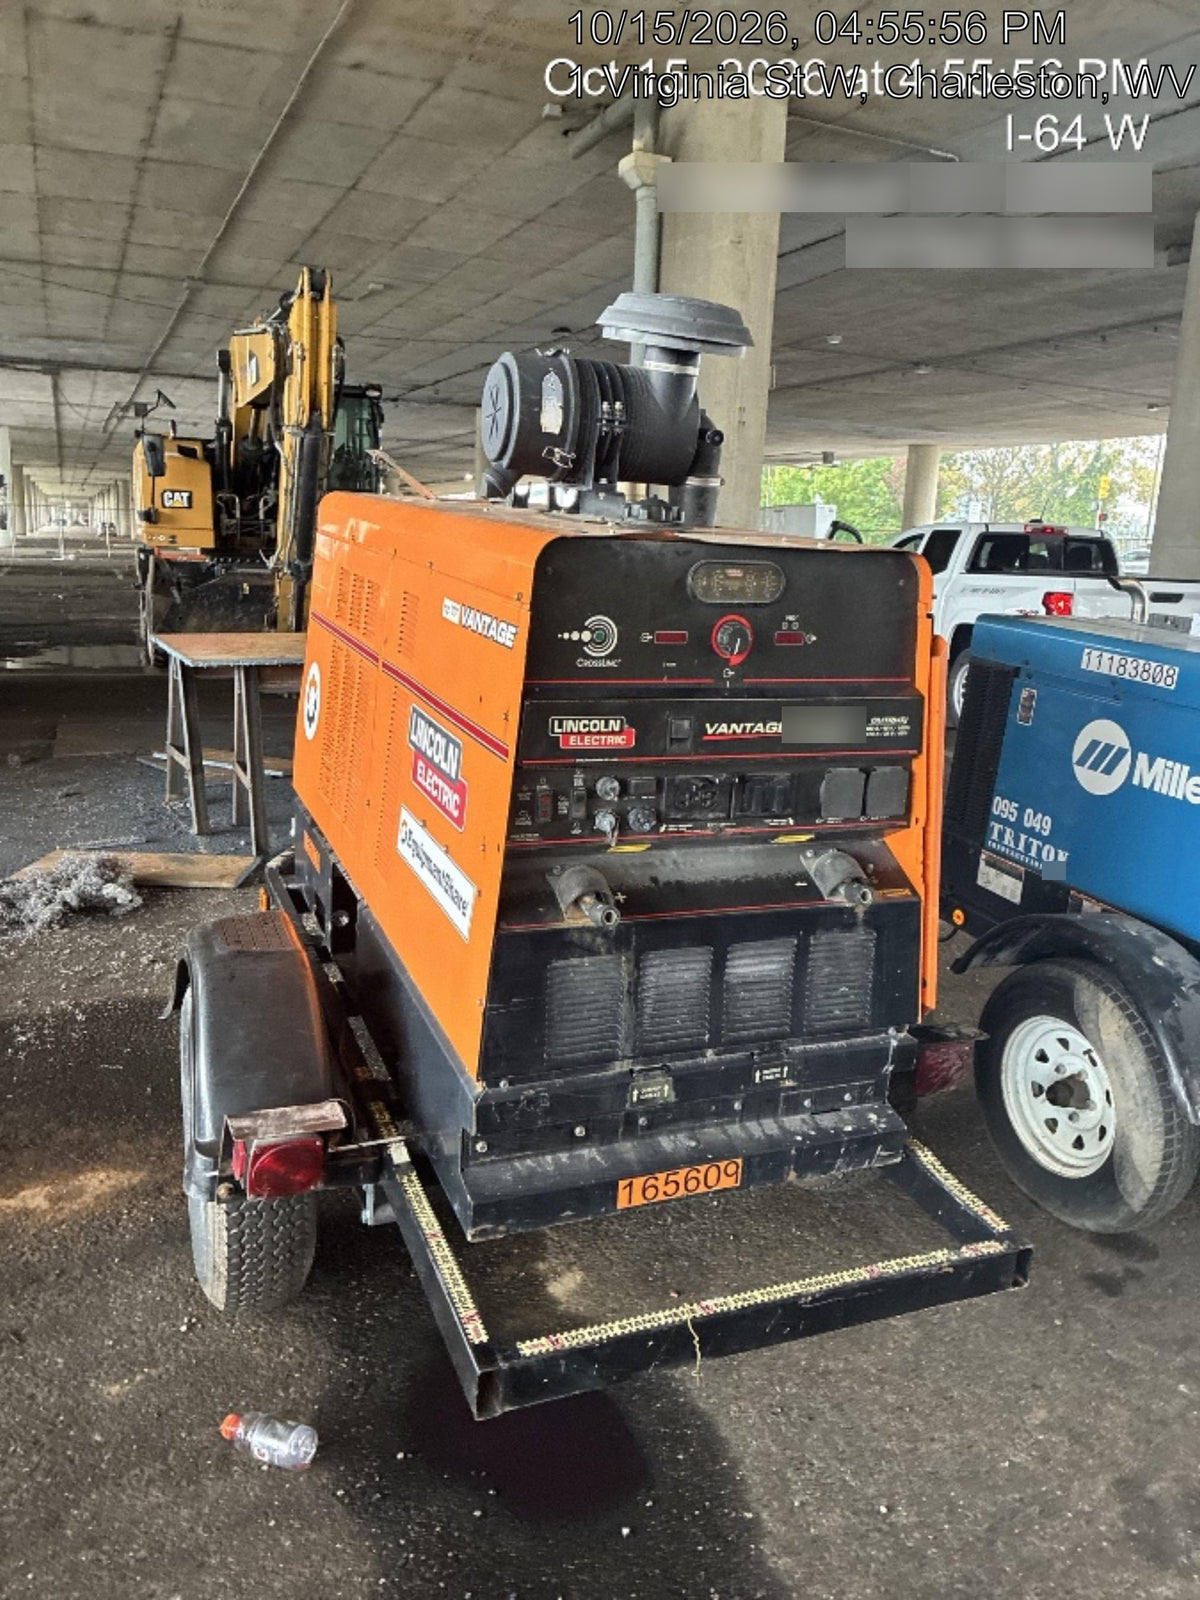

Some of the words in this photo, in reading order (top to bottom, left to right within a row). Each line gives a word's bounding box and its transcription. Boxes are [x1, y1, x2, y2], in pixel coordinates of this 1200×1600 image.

[163, 490, 190, 508] CAT
[461, 603, 518, 650] VANTAGE
[1084, 650, 1177, 688] 11183808
[410, 711, 459, 780] LINCOLN
[554, 719, 621, 733] LINCOLN
[569, 735, 627, 746] ELECTRIC
[416, 757, 460, 819] ELECTRIC
[992, 796, 1019, 822] 095
[1023, 808, 1052, 836] 049
[622, 1160, 740, 1205] 165609
